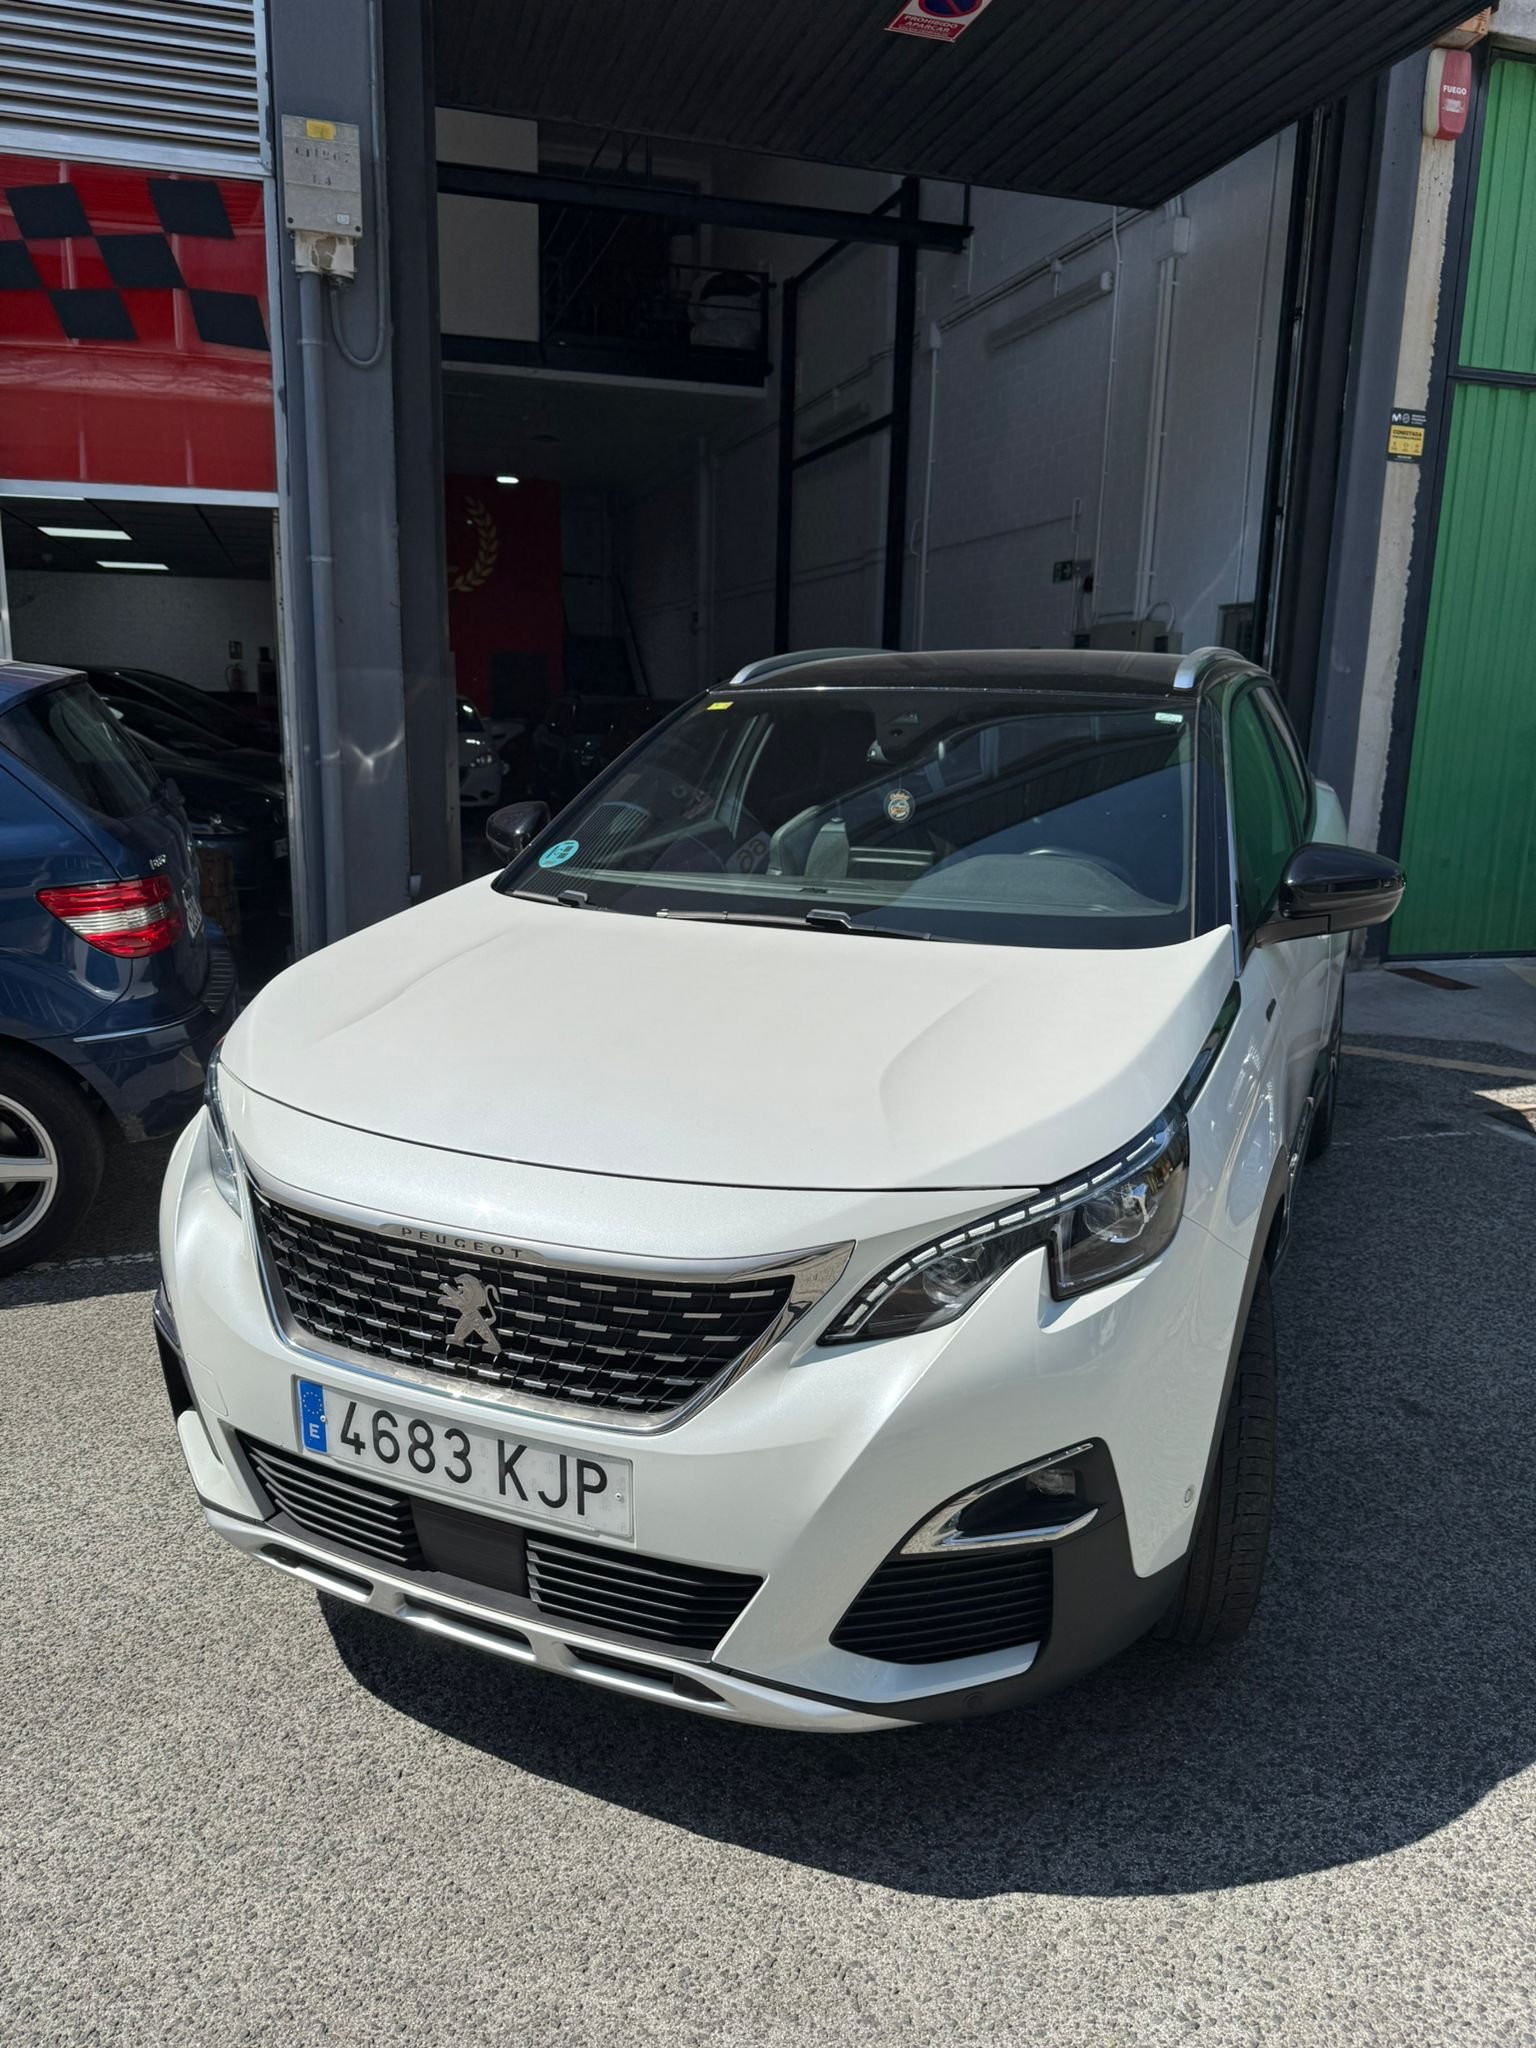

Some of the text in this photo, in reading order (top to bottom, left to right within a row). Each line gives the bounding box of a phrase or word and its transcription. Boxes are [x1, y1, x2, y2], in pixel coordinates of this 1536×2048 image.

[903, 15, 958, 29] PROHIBIDO
[905, 21, 950, 33] APARCAR
[1443, 84, 1467, 96] FUEGO
[401, 1226, 523, 1258] PEUGEOT
[309, 1424, 320, 1439] E
[340, 1401, 608, 1516] 4683 KJP
